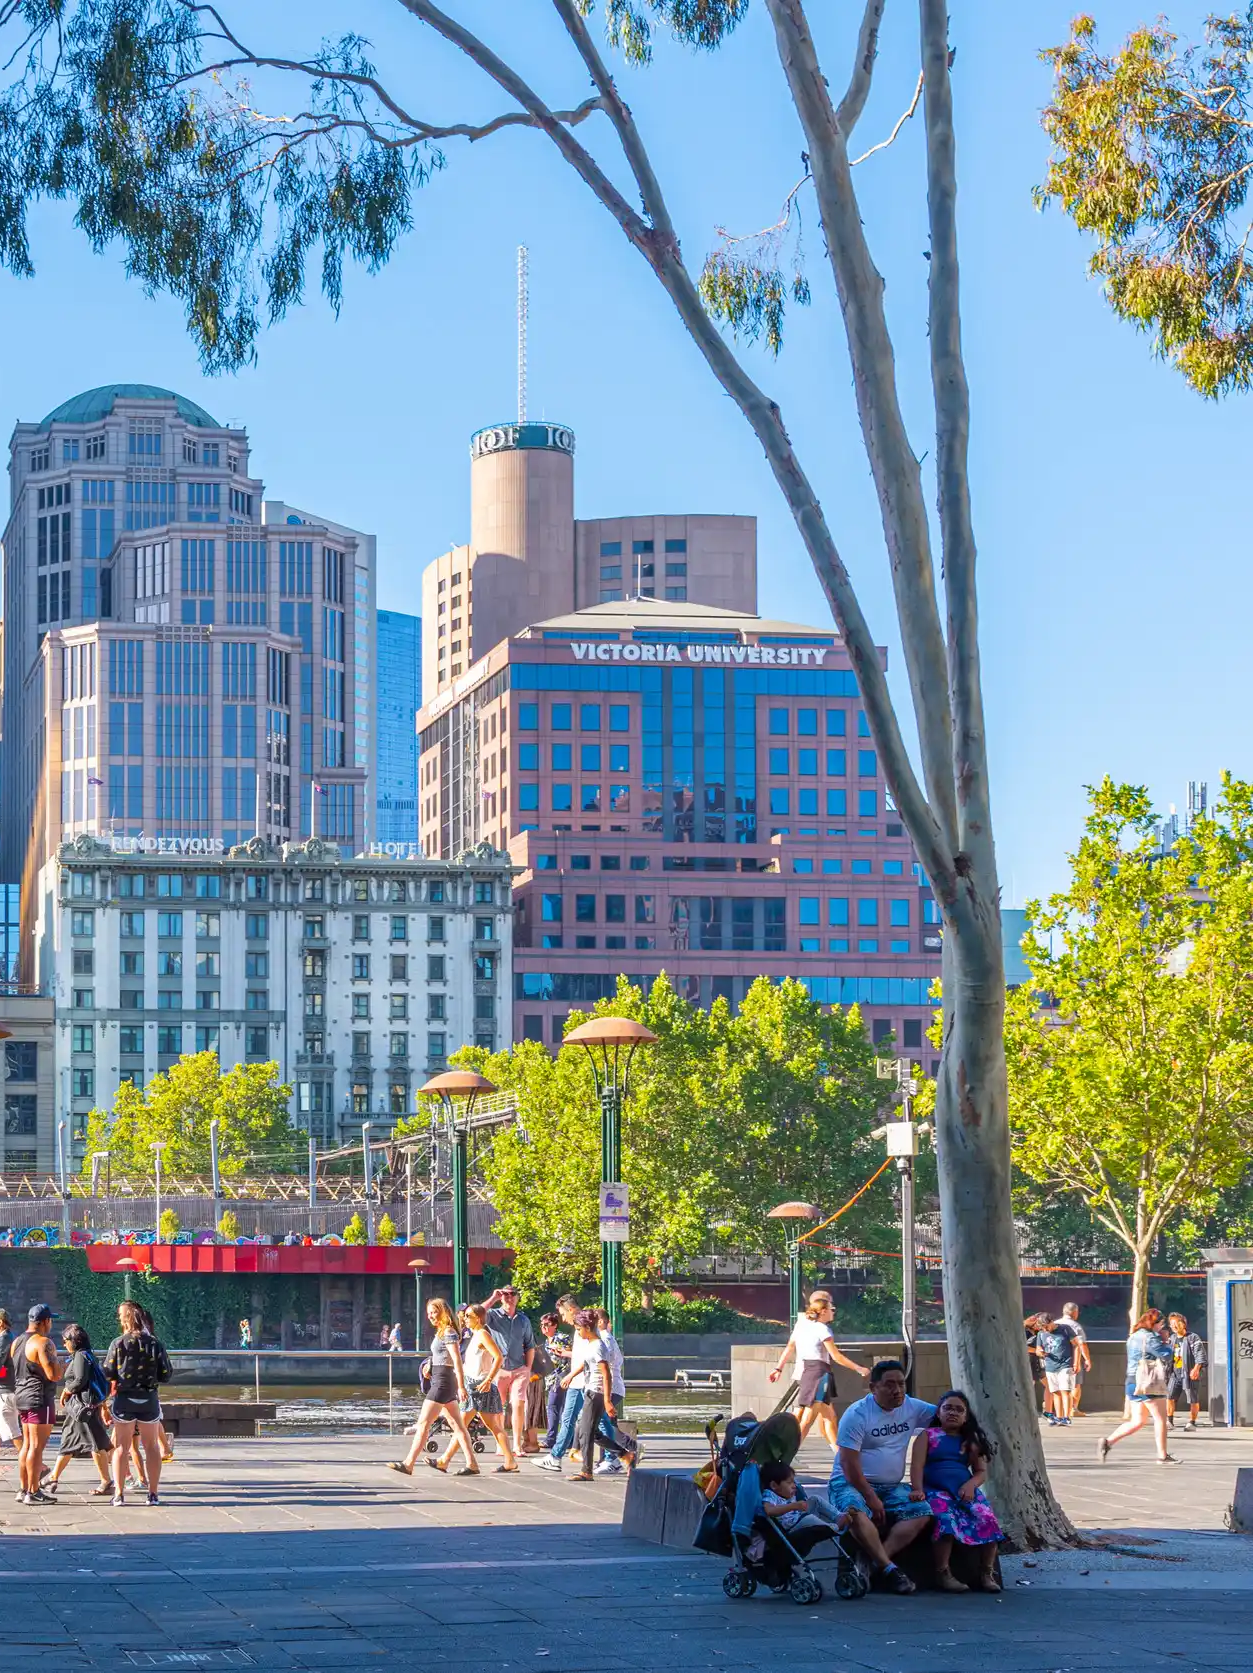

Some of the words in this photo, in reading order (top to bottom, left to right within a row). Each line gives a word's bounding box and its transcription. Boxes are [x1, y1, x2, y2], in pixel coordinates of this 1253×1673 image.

[545, 426, 576, 453] IOO
[570, 642, 682, 662] VICTORIA
[687, 644, 827, 666] UNIVERSITY
[112, 836, 225, 852] RENDEZVOUS
[370, 841, 422, 856] HOTEL
[870, 1421, 911, 1438] adidas
